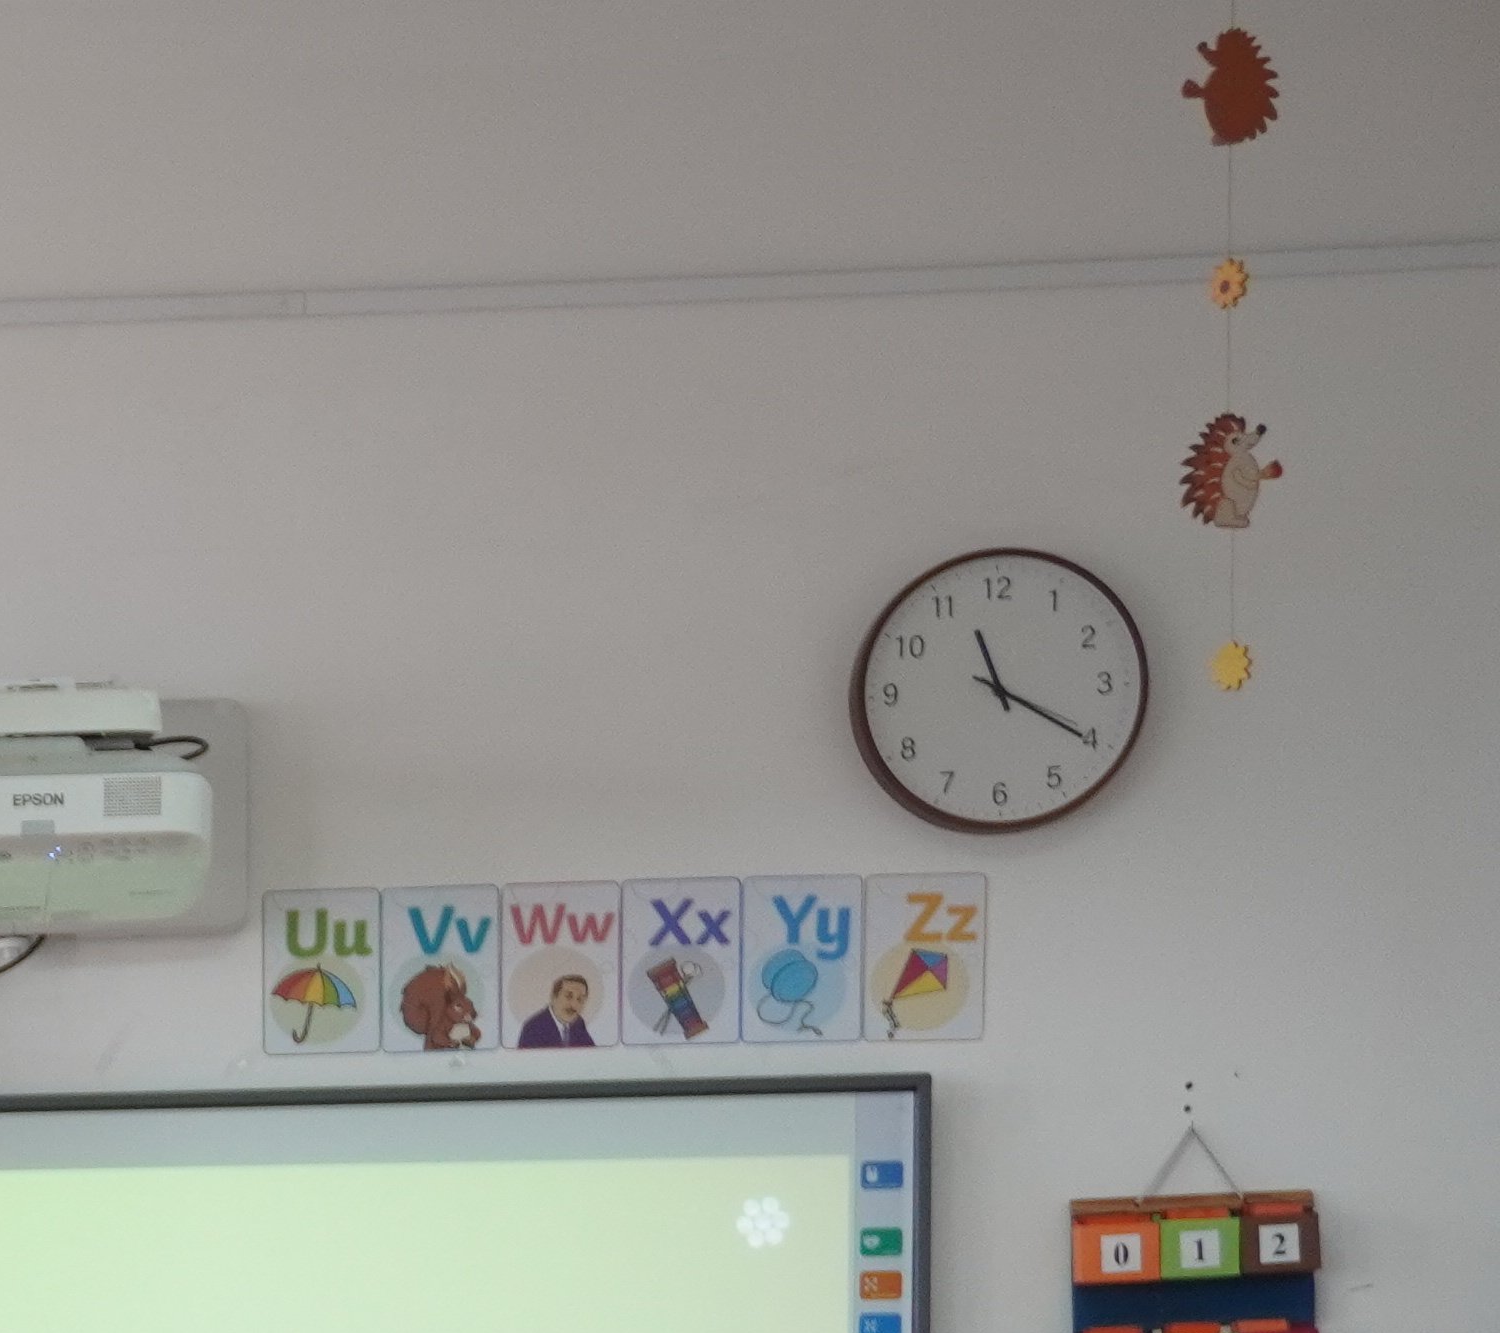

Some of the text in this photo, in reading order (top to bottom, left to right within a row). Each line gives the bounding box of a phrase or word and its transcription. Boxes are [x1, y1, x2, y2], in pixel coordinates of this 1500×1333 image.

[983, 577, 1011, 600] 12
[932, 595, 954, 618] 11
[1049, 590, 1058, 611] 1
[896, 634, 925, 658] 10
[1081, 626, 1097, 648] 2
[1097, 671, 1113, 693] 3
[883, 683, 898, 706] 9
[901, 737, 915, 761] 8
[1083, 727, 1098, 750] 4
[940, 771, 954, 794] 7
[1047, 765, 1061, 789] 5
[13, 793, 65, 806] EPSON
[993, 783, 1007, 806] 6
[285, 892, 978, 960] Uu Vv Ww Xx Yy Zz
[1114, 1242, 1129, 1265] 0
[1193, 1238, 1205, 1262] 1
[1272, 1233, 1287, 1256] 2
